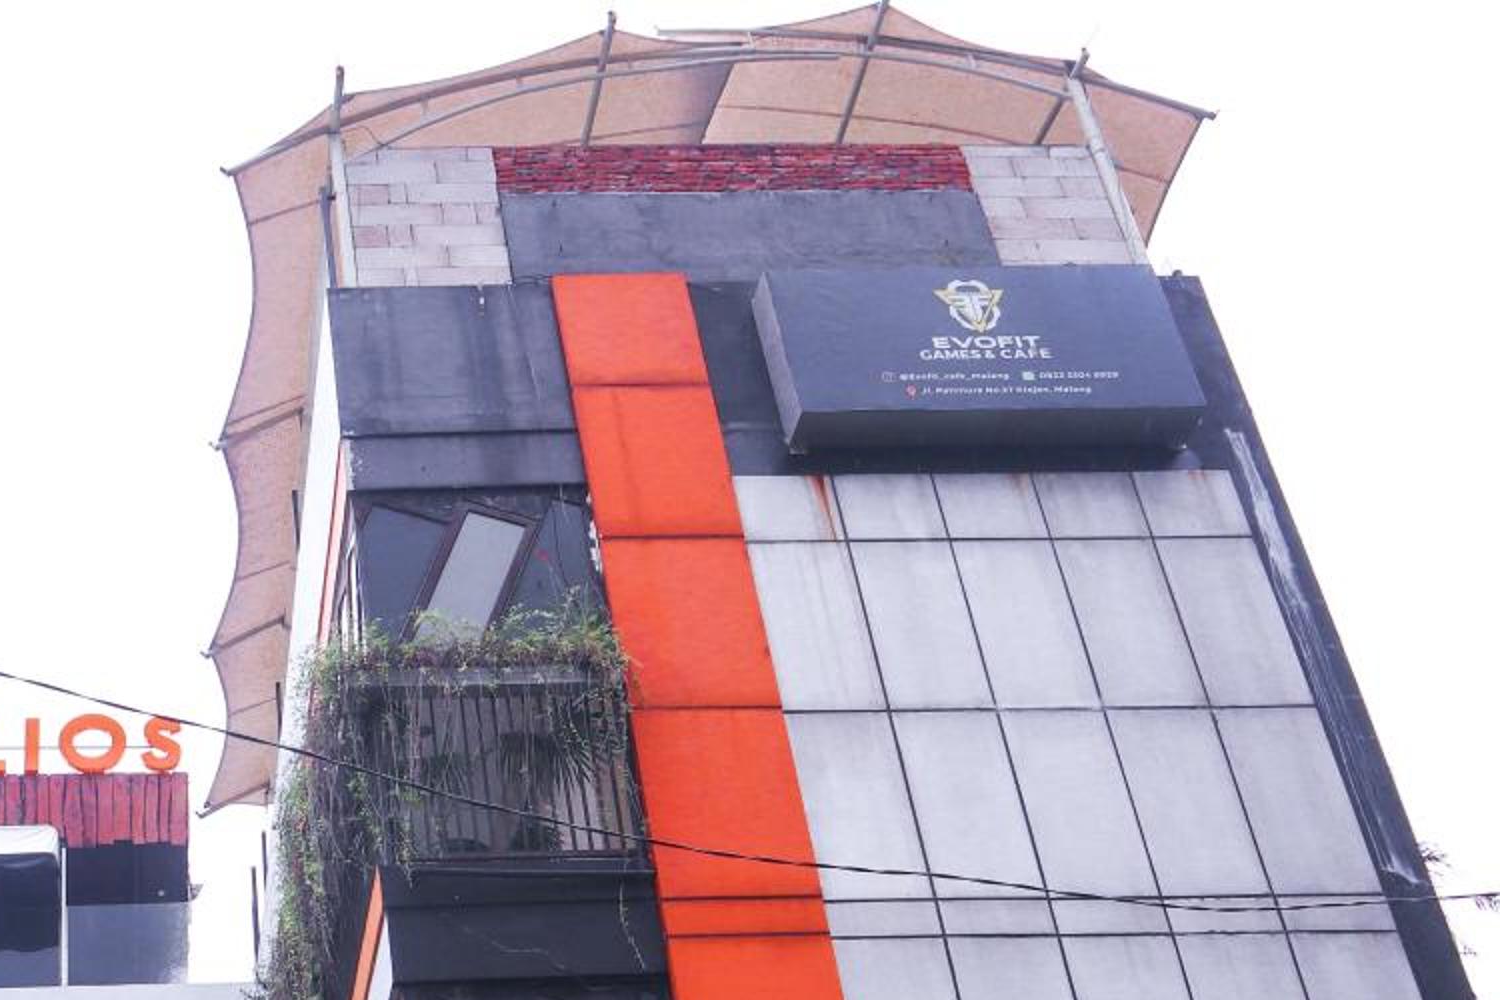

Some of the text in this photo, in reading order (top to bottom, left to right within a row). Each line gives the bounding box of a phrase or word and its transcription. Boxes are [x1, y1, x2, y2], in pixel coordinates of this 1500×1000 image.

[932, 336, 1040, 348] EVOFIT
[920, 349, 1054, 360] GAMES & CAFE
